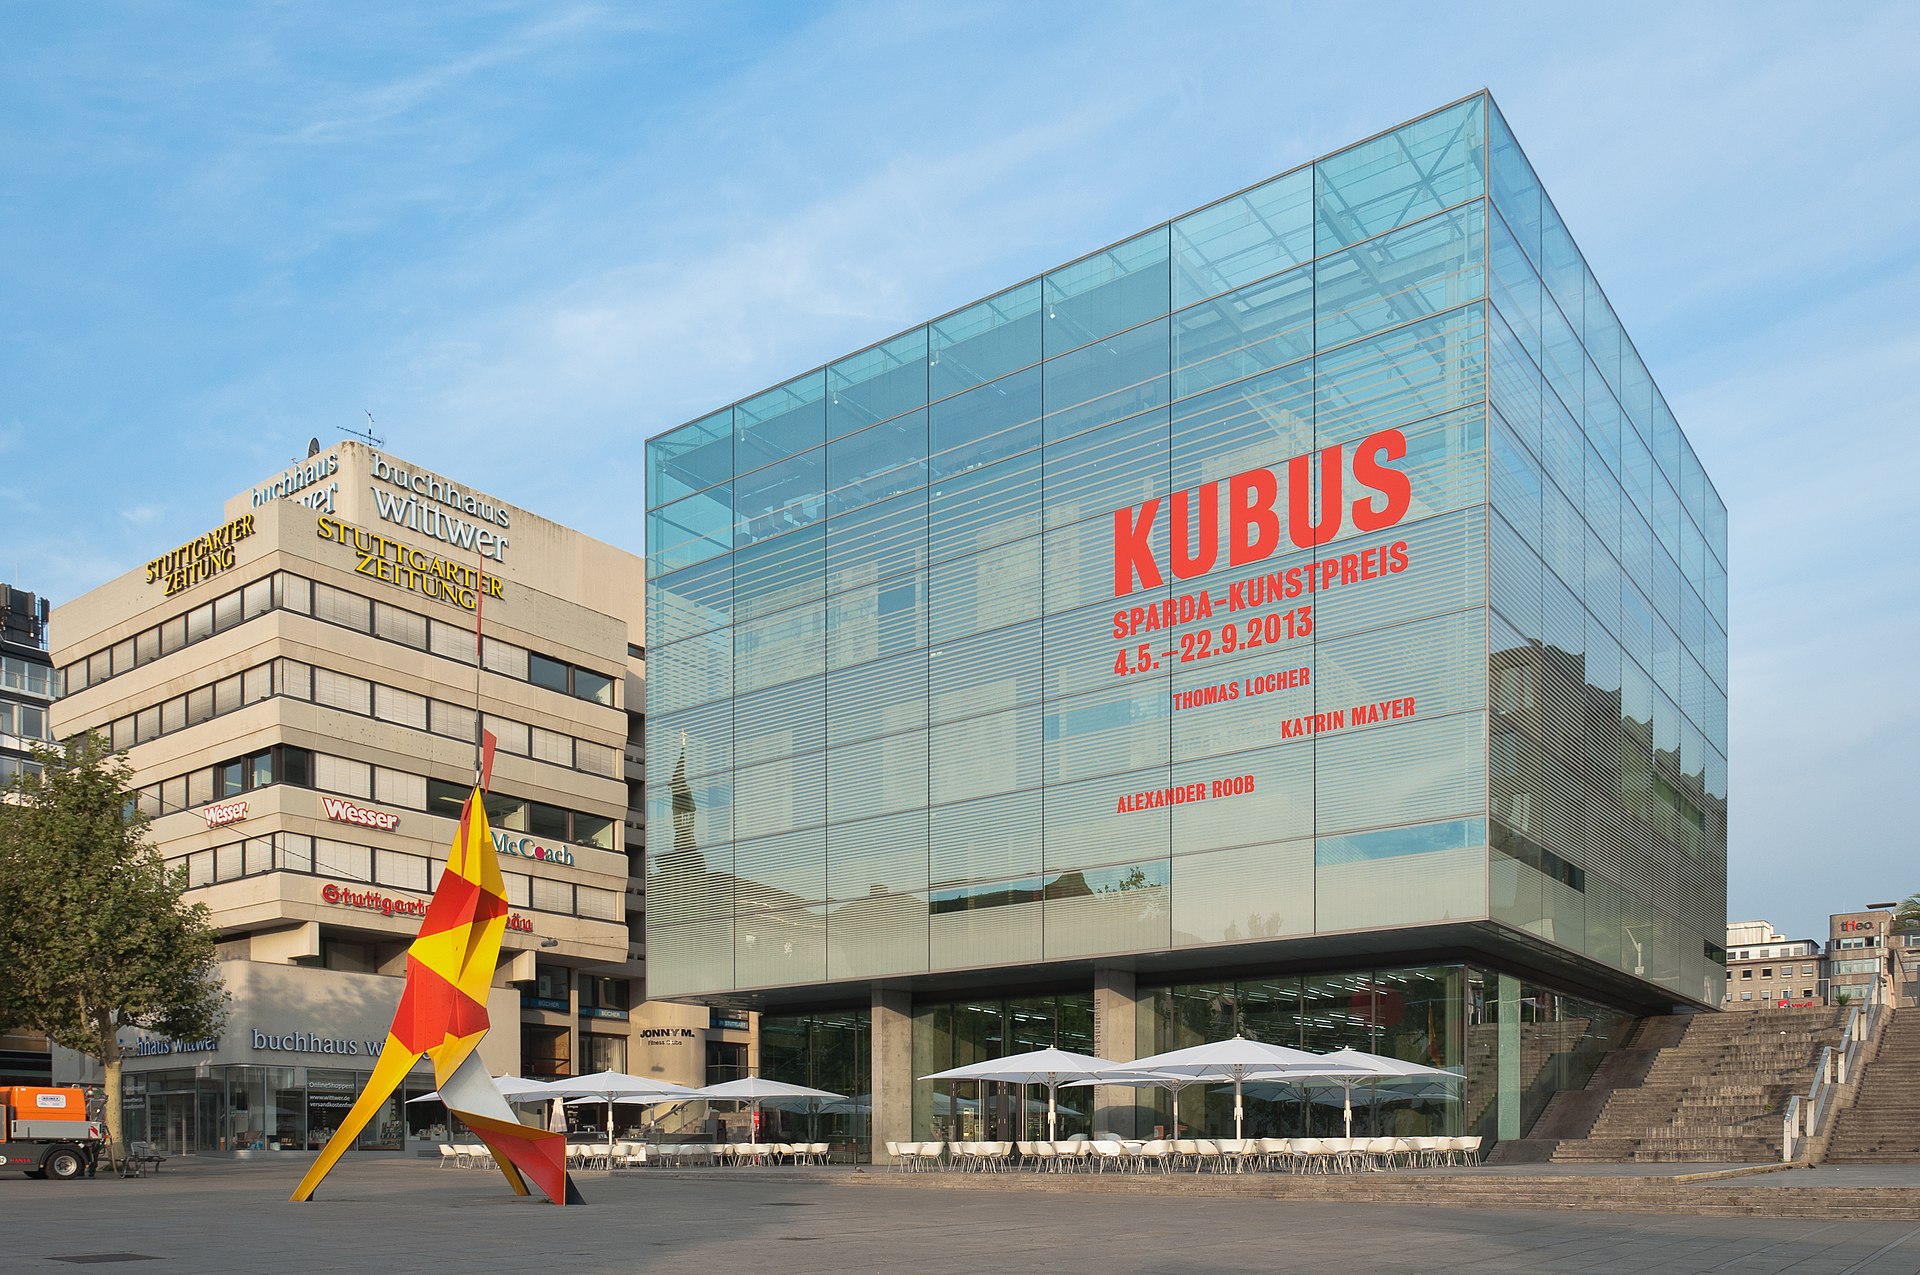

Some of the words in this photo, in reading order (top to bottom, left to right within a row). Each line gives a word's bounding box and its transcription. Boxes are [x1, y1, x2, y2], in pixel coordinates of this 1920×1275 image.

[371, 453, 509, 528] buchhaus
[1114, 429, 1411, 597] KUBUS
[145, 513, 256, 585] STUTTGARTER
[371, 486, 509, 563] wittwer
[164, 545, 236, 597] ZEITUNG
[318, 516, 504, 600] STUTTGARTER
[355, 551, 476, 610] ZEITUNG
[1113, 541, 1409, 639] SPARDA-KUNSTPREIS
[1173, 681, 1239, 711] THOMAS
[1245, 667, 1310, 697] LOCHER
[1281, 710, 1344, 738] KATRIN
[1351, 697, 1416, 726] MAYER
[204, 802, 248, 828] Wesser
[321, 797, 400, 831] Wesser
[1117, 783, 1206, 813] ALEXANDER
[1212, 775, 1255, 798] ROOB
[252, 1029, 358, 1055] buchhaus
[640, 1029, 679, 1038] JONNY
[681, 1029, 695, 1038] M.
